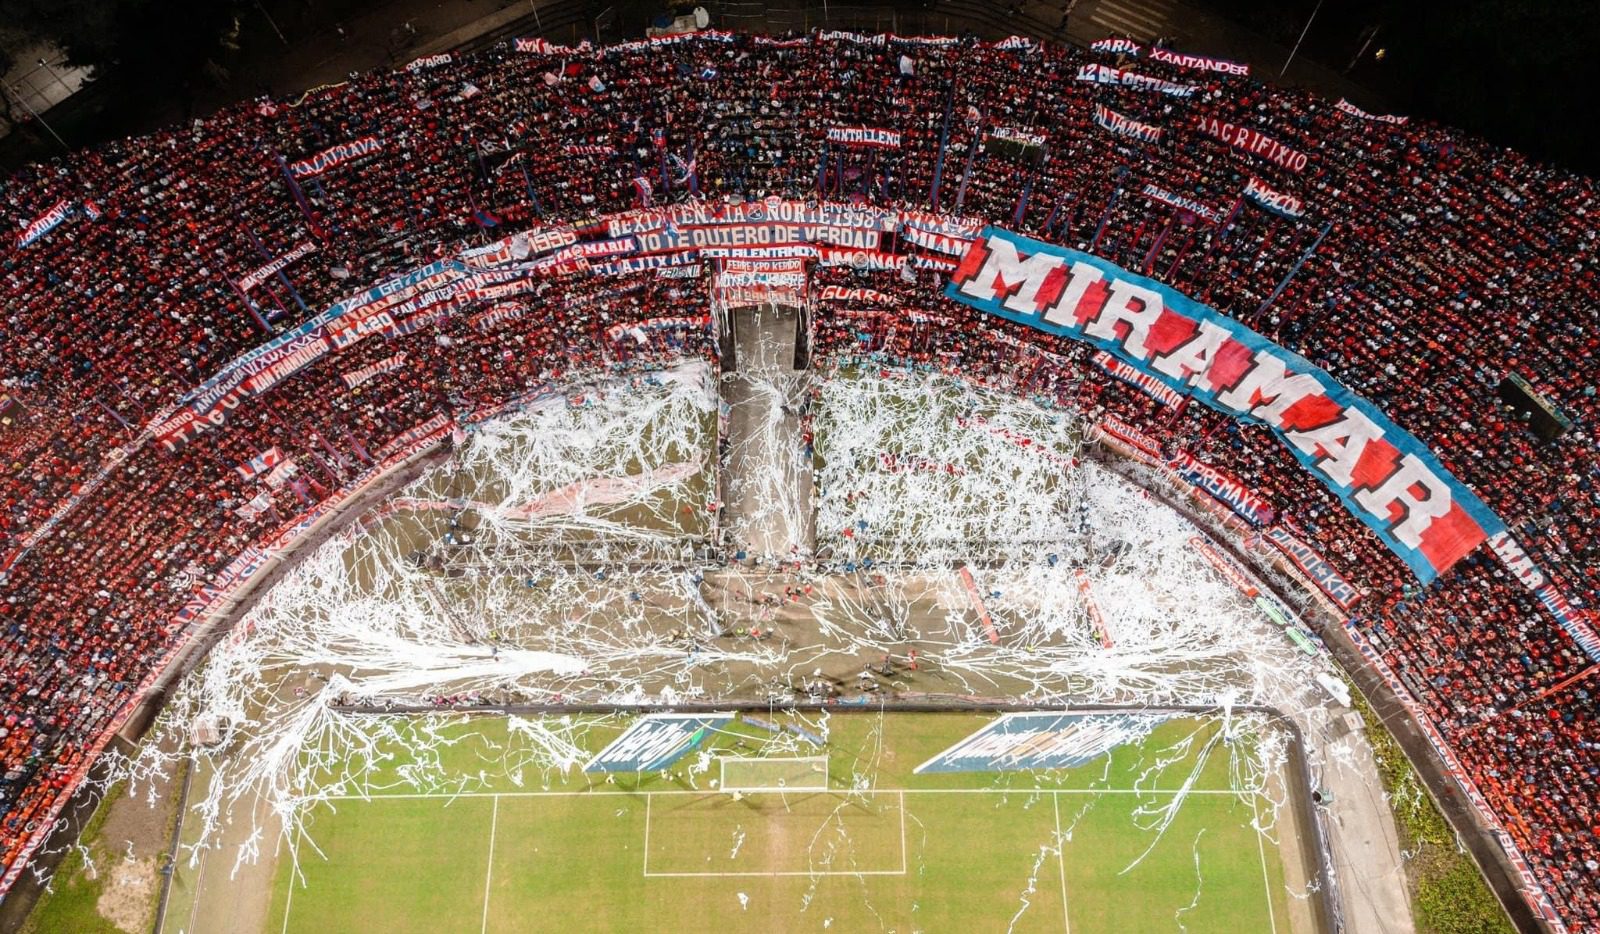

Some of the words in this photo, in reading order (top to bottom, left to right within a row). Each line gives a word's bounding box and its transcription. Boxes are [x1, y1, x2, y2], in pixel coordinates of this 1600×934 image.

[1091, 39, 1141, 56] PARIX
[1076, 63, 1098, 81] 12
[1098, 66, 1120, 84] DE
[1149, 47, 1249, 76] XANTANDER
[1197, 115, 1308, 171] XACRIFIXIO
[291, 136, 382, 178] KALATRAVA
[529, 229, 577, 253] 1995
[583, 239, 635, 254] MARIA
[636, 233, 661, 252] YO
[692, 225, 771, 247] QUIERO
[774, 224, 801, 243] DE
[804, 226, 879, 250] VERDAD
[310, 311, 332, 329] DE
[960, 235, 1452, 551] MIRAMAR
[154, 411, 194, 437] BARRIO
[415, 413, 448, 439] ROJO
[1538, 584, 1571, 619] VILLA
